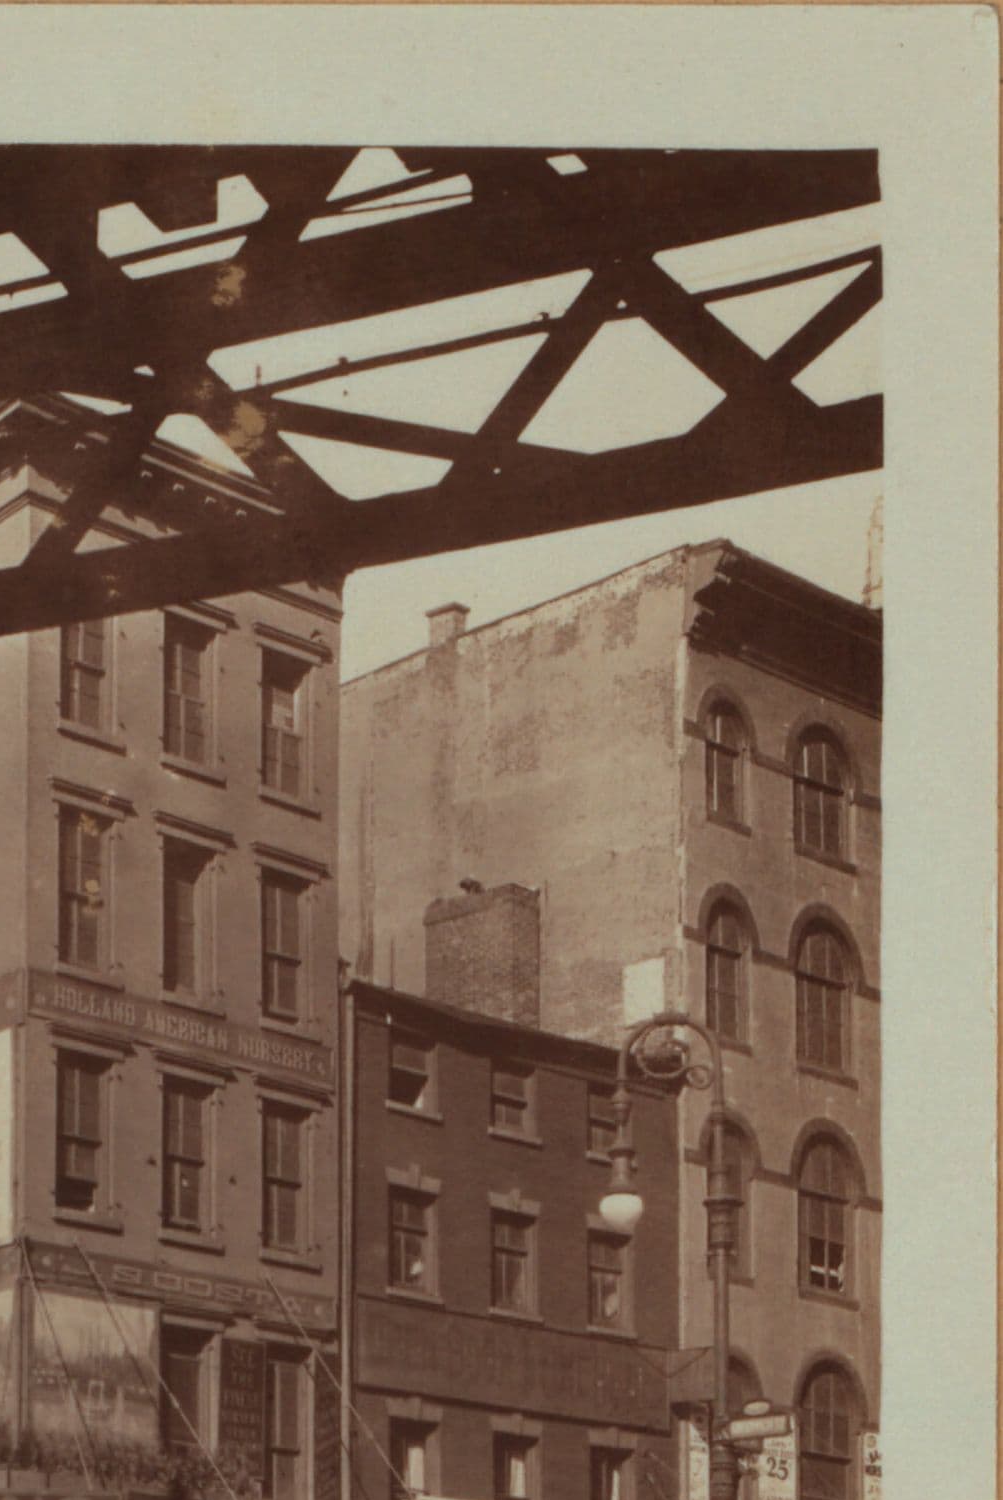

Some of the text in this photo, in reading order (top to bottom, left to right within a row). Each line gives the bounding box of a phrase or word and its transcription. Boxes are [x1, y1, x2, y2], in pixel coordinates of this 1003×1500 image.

[53, 984, 314, 1072] HOLLAND AMERICAN NURSERY
[153, 1270, 302, 1314] COSTA
[766, 1456, 789, 1481] 25
